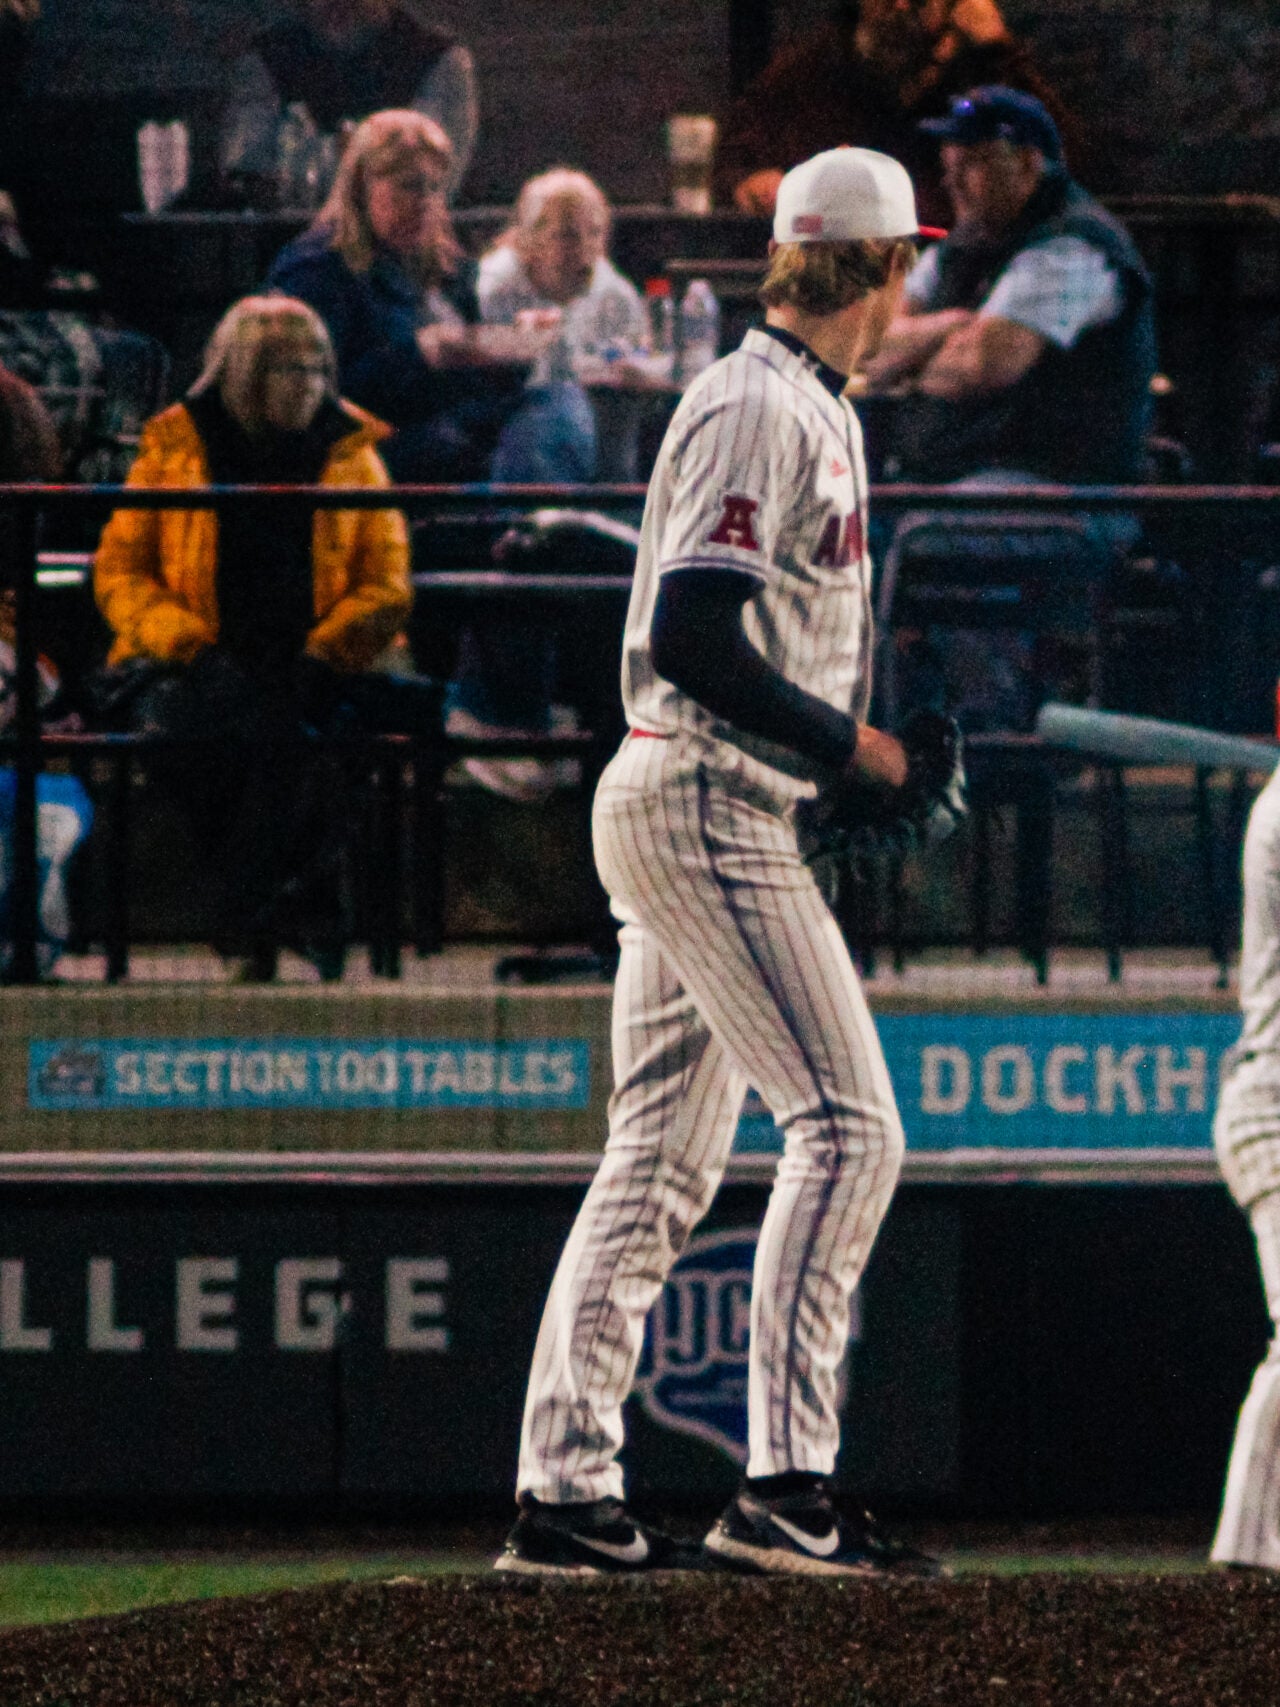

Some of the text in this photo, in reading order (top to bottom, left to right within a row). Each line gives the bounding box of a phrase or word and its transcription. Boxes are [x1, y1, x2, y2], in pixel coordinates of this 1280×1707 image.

[707, 496, 759, 551] A
[115, 1050, 576, 1095] SECTION 100 TABLES
